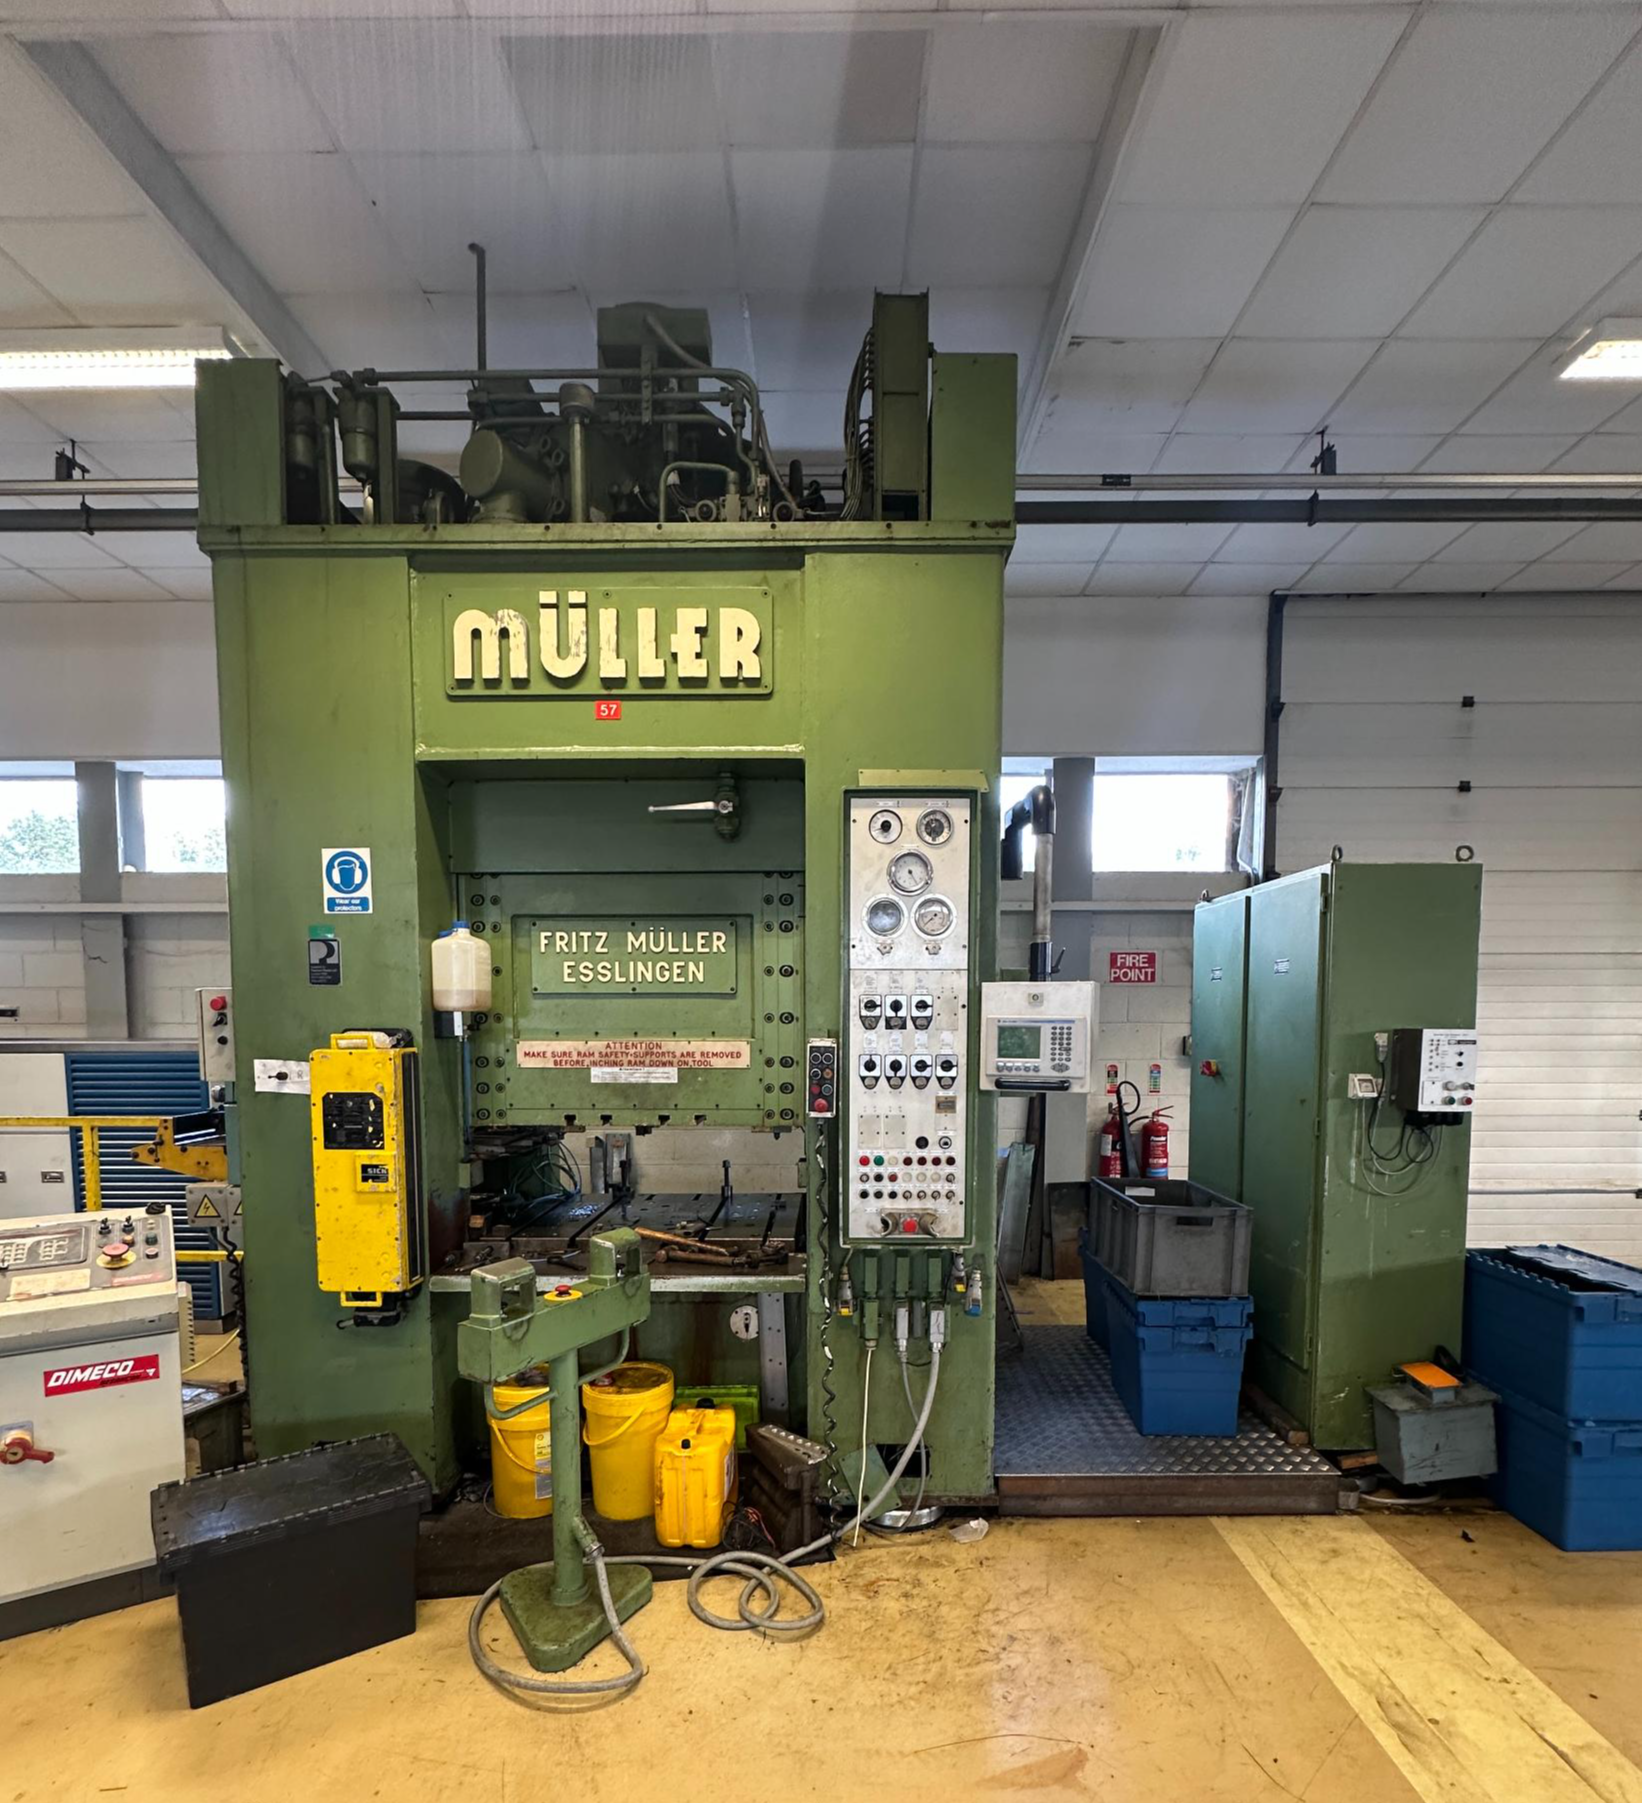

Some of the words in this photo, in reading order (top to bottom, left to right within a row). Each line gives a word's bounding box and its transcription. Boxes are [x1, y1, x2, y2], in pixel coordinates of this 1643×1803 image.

[453, 590, 761, 681] MÜLLER
[600, 704, 617, 716] 57
[539, 931, 609, 953] FRITZ
[627, 927, 726, 953] MÜLLER
[1117, 954, 1149, 967] FIRE
[563, 961, 704, 983] ESSLINGEN
[1110, 968, 1155, 981] POINT
[605, 1042, 662, 1050] ATTENTION
[47, 1360, 135, 1387] DIMECO
